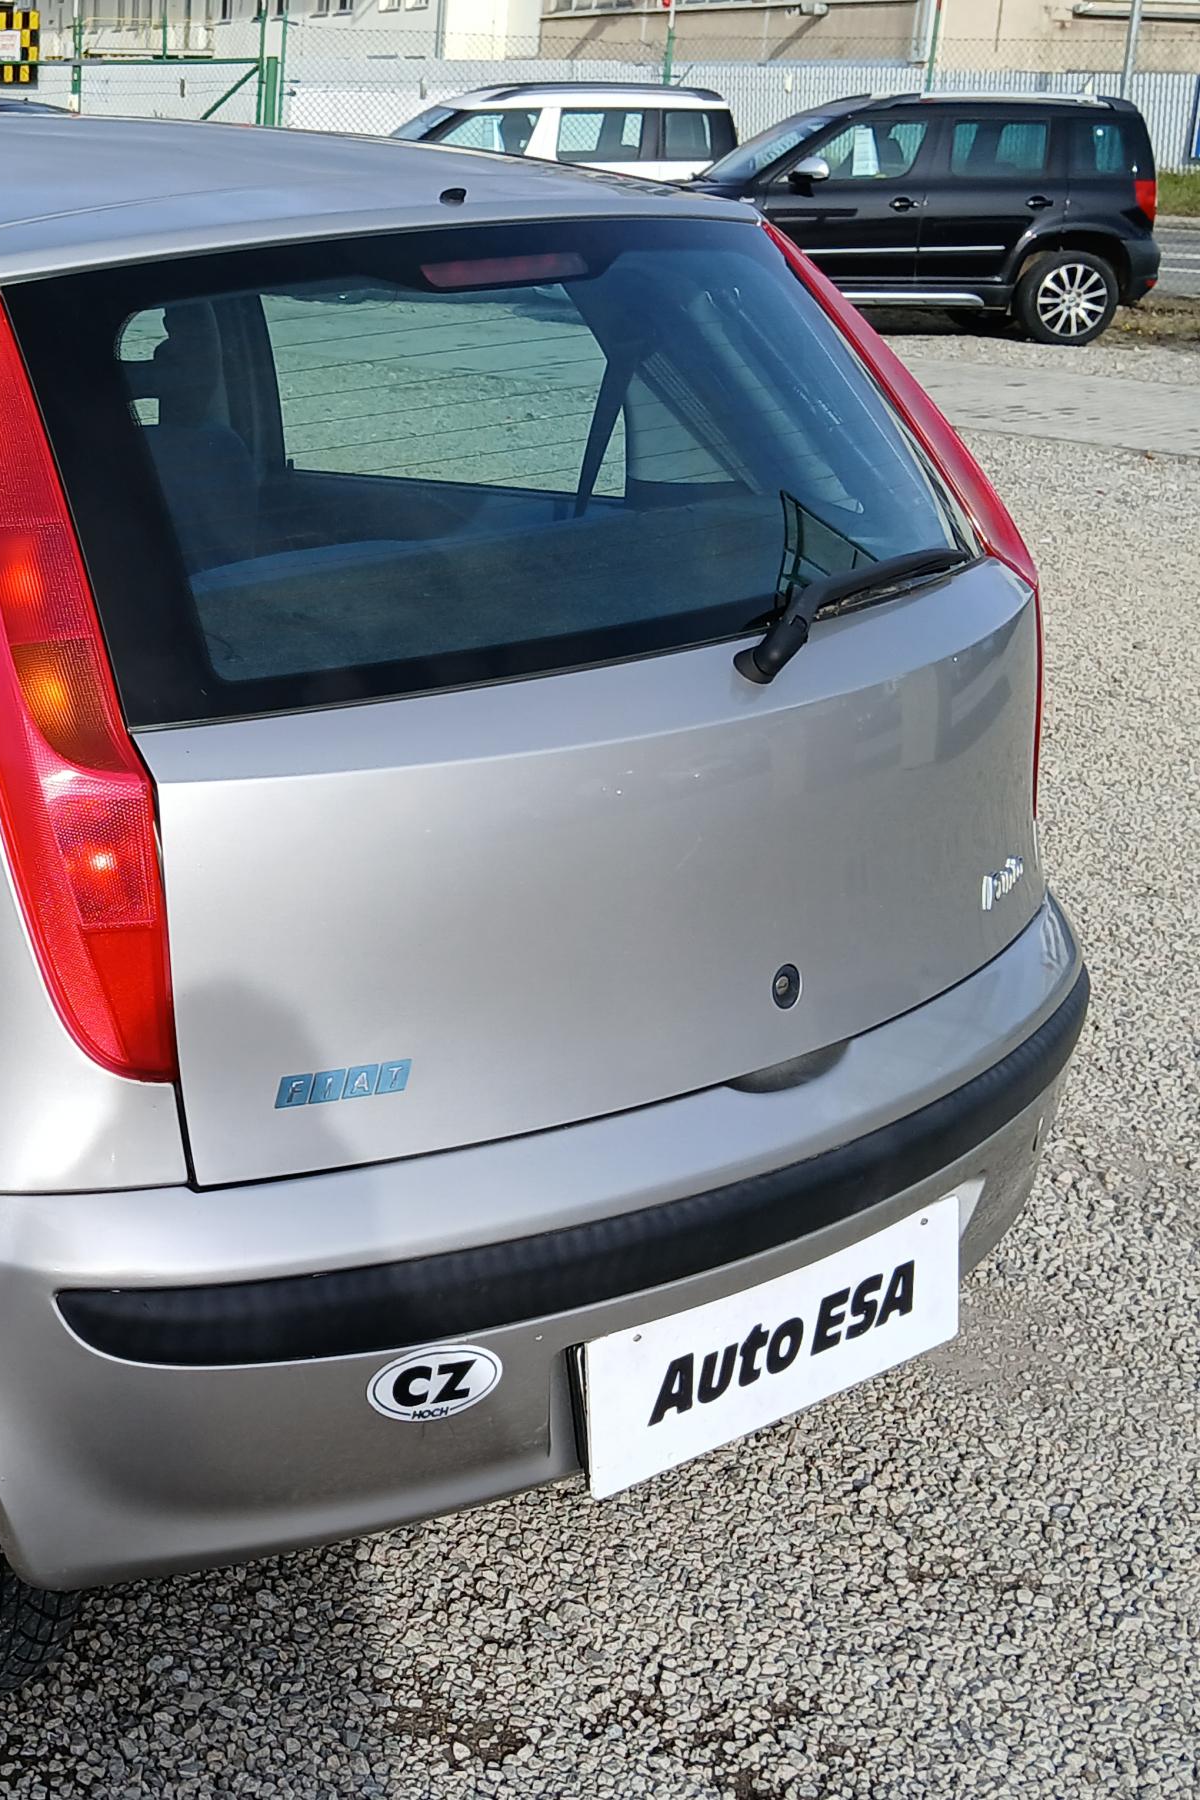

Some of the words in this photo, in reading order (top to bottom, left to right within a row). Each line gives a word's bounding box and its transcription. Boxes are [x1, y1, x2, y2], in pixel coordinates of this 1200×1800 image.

[284, 1065, 406, 1105] FIAT
[392, 1358, 478, 1407] CZ
[411, 1406, 449, 1430] HOCH
